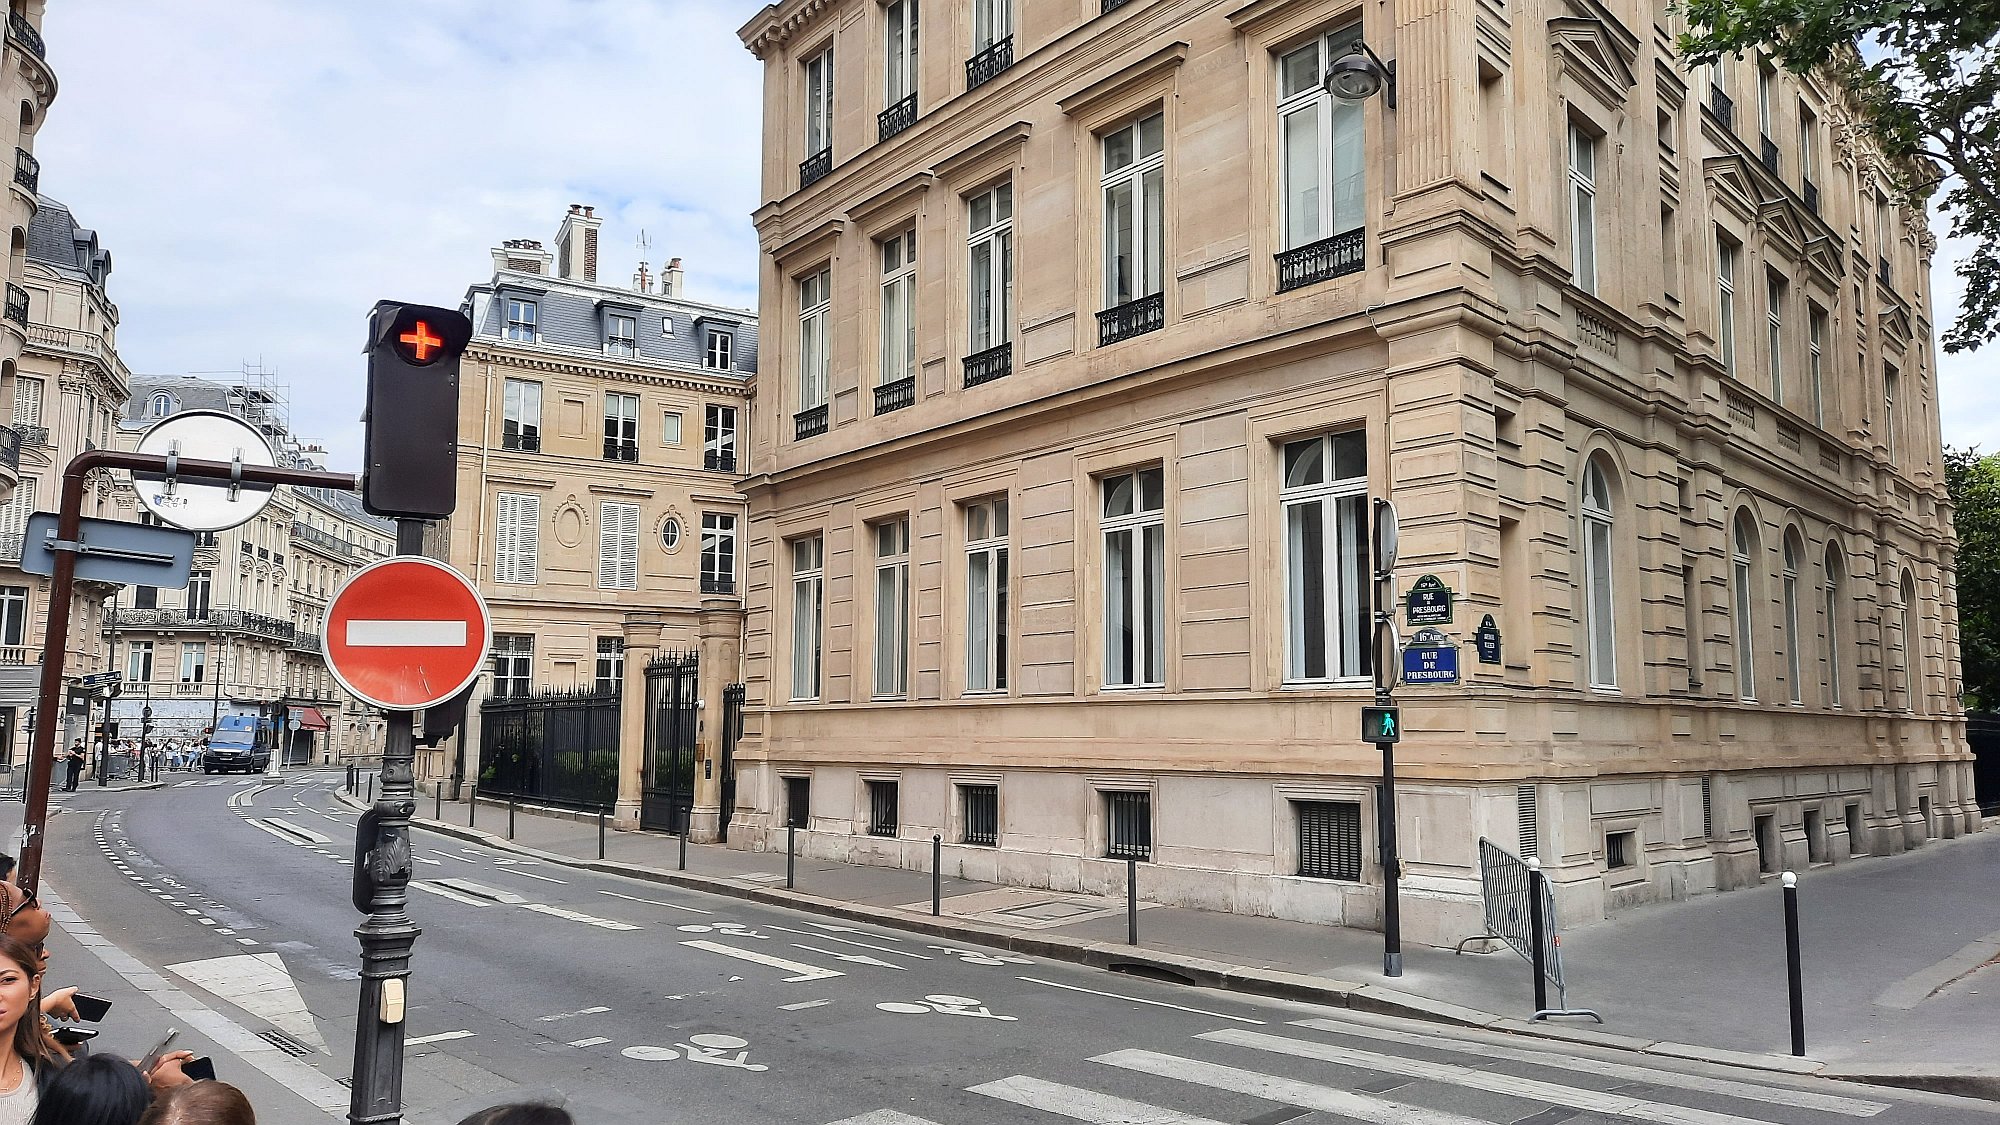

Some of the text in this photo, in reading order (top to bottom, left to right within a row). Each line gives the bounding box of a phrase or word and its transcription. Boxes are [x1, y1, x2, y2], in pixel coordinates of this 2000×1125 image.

[1423, 593, 1434, 601] RUE
[1413, 605, 1446, 614] PRESBOURG
[1421, 652, 1438, 660] RUE
[1423, 661, 1436, 669] DE
[1407, 671, 1454, 679] PRESBOURG
